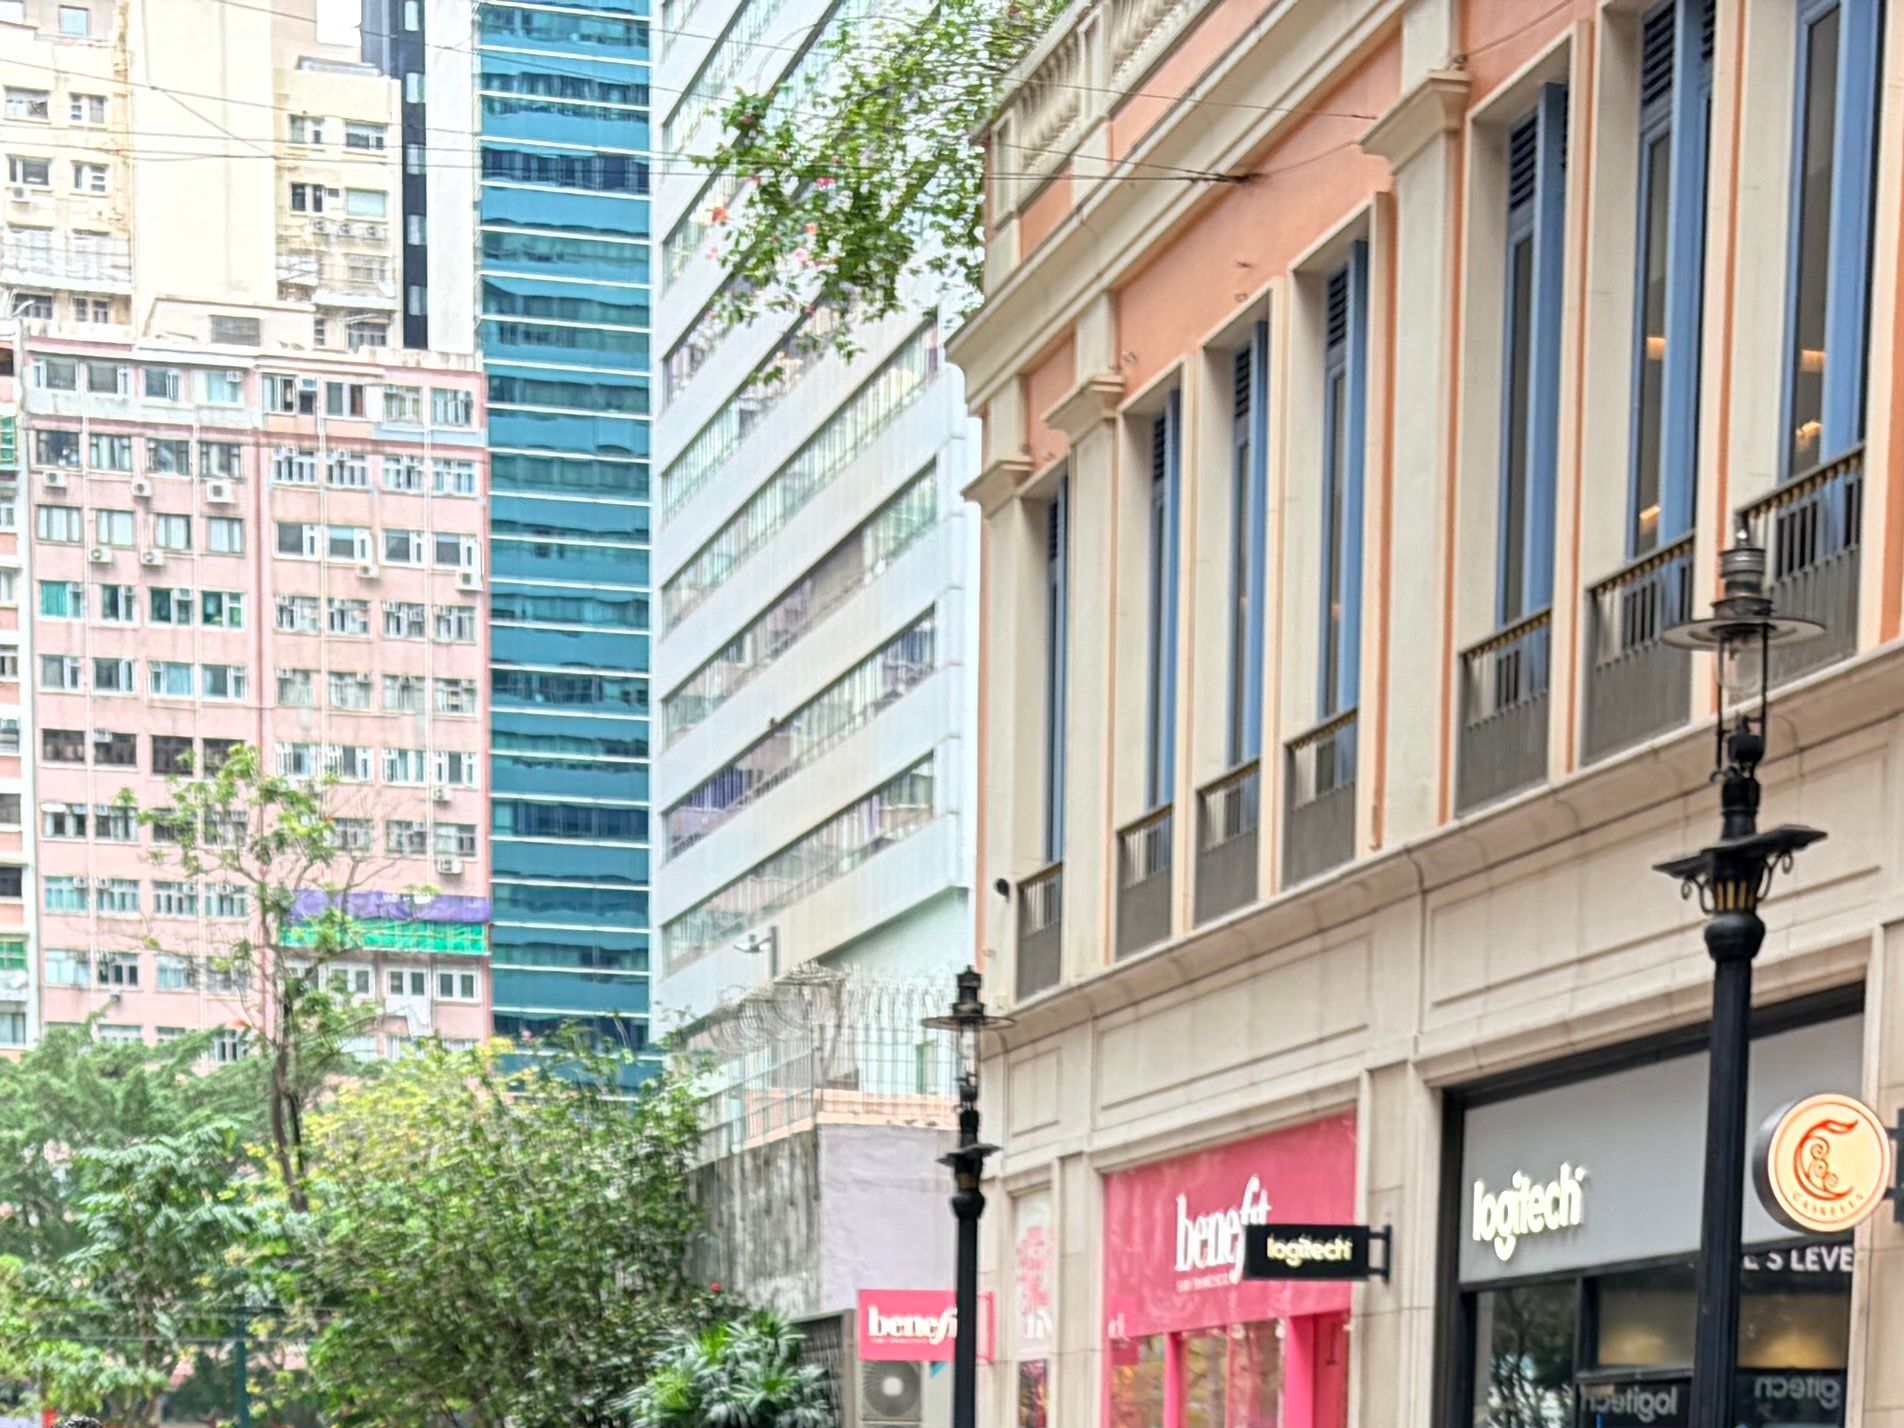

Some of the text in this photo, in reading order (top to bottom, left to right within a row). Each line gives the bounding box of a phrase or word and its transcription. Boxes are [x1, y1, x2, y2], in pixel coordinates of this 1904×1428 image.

[1472, 1162, 1583, 1262] logitech
[1266, 1234, 1352, 1266] logitech
[867, 1305, 958, 1345] benefi
